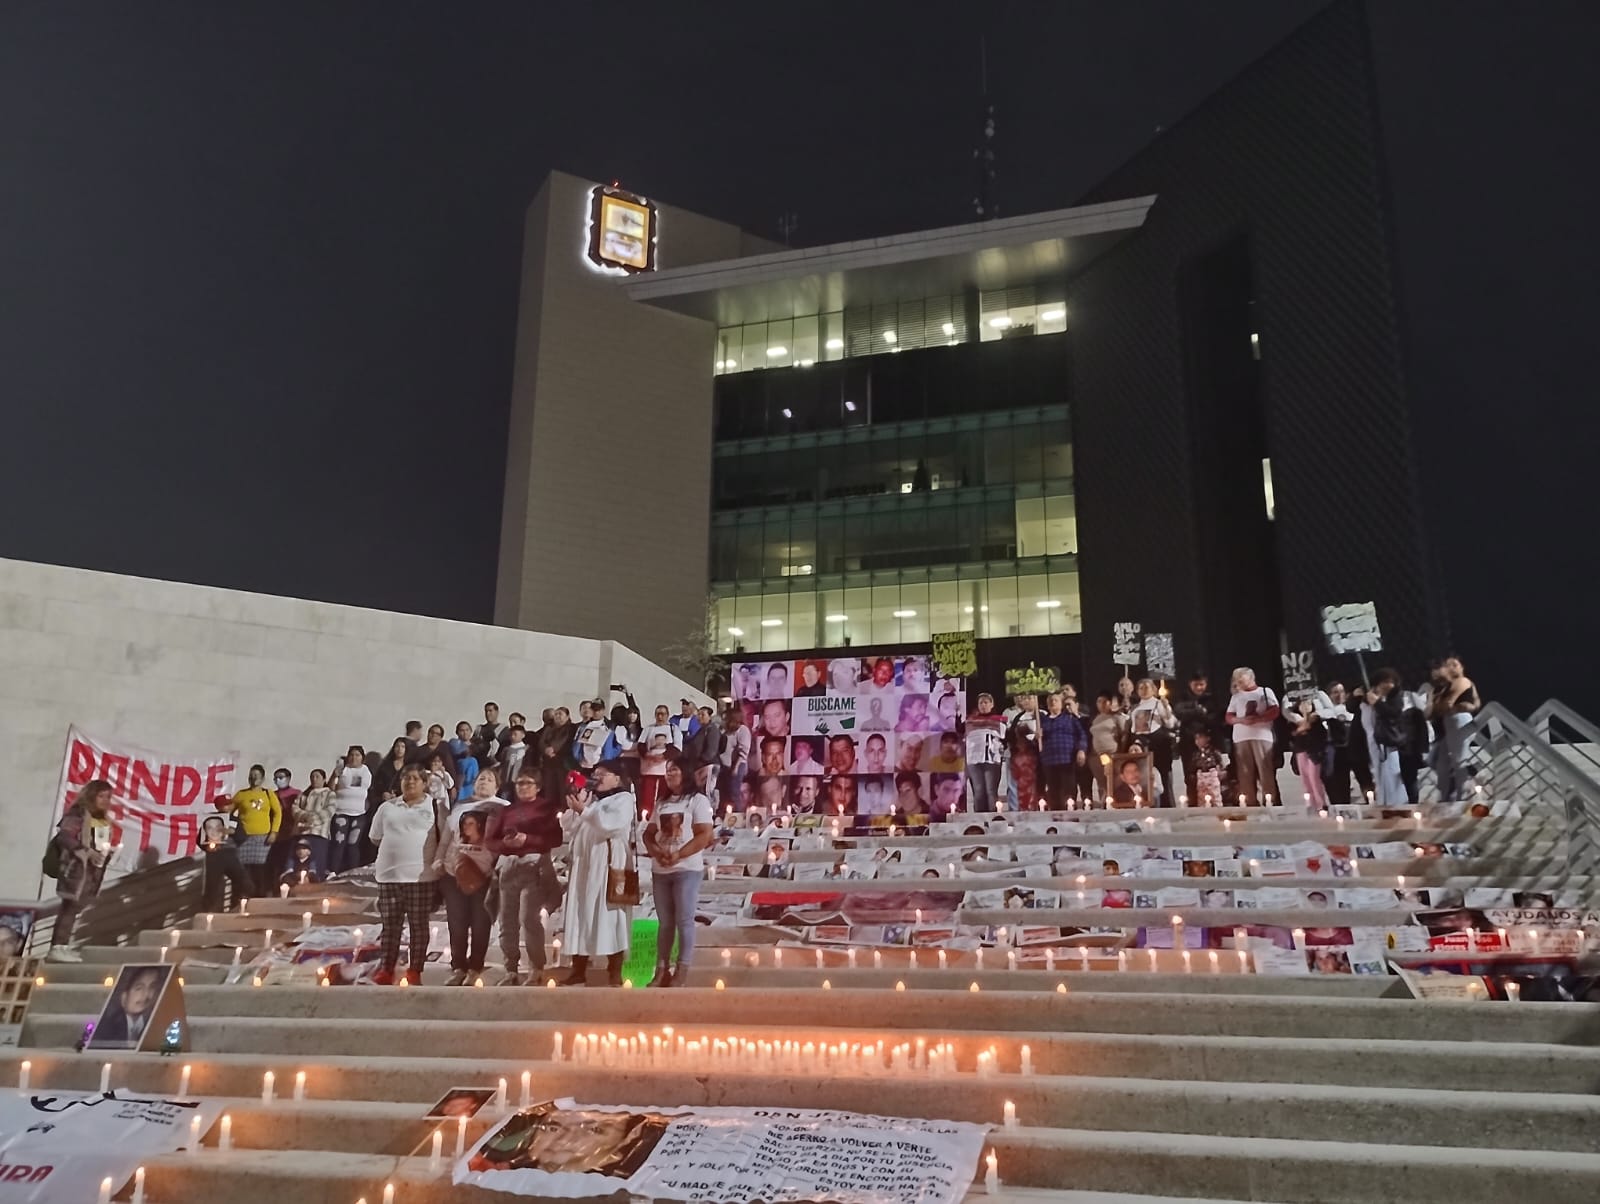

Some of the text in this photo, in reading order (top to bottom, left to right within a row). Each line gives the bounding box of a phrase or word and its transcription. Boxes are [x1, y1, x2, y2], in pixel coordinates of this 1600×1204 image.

[1281, 651, 1313, 669] NO
[808, 697, 856, 711] BUSCAME
[68, 739, 234, 806] DONDE
[896, 1141, 932, 1155] VERTE
[831, 1154, 850, 1163] DIA
[853, 1156, 876, 1165] POR
[831, 1162, 857, 1171] DIOS
[871, 1167, 896, 1175] CON
[819, 1177, 855, 1189] ESTOY
